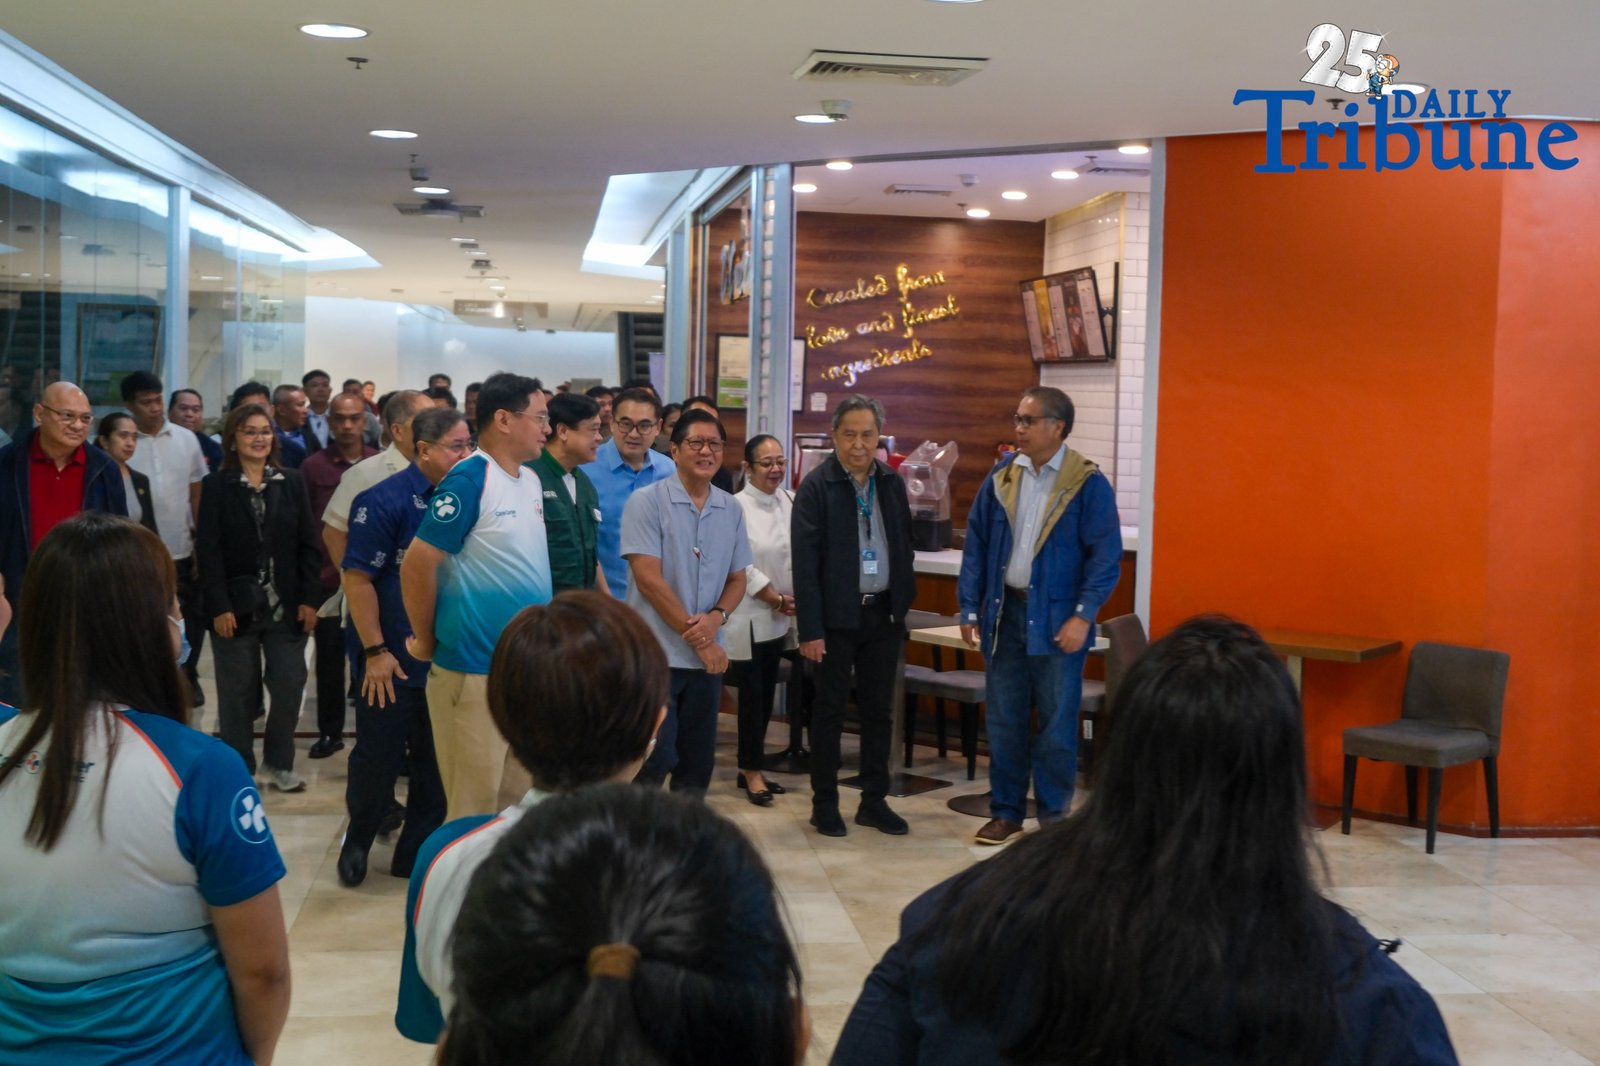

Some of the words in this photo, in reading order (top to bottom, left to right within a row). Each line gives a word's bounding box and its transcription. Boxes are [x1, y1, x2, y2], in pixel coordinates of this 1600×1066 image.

[806, 274, 889, 309] Created
[896, 262, 946, 302] from
[856, 311, 895, 335] and
[902, 294, 960, 339] finest
[820, 339, 933, 387] ingredients
